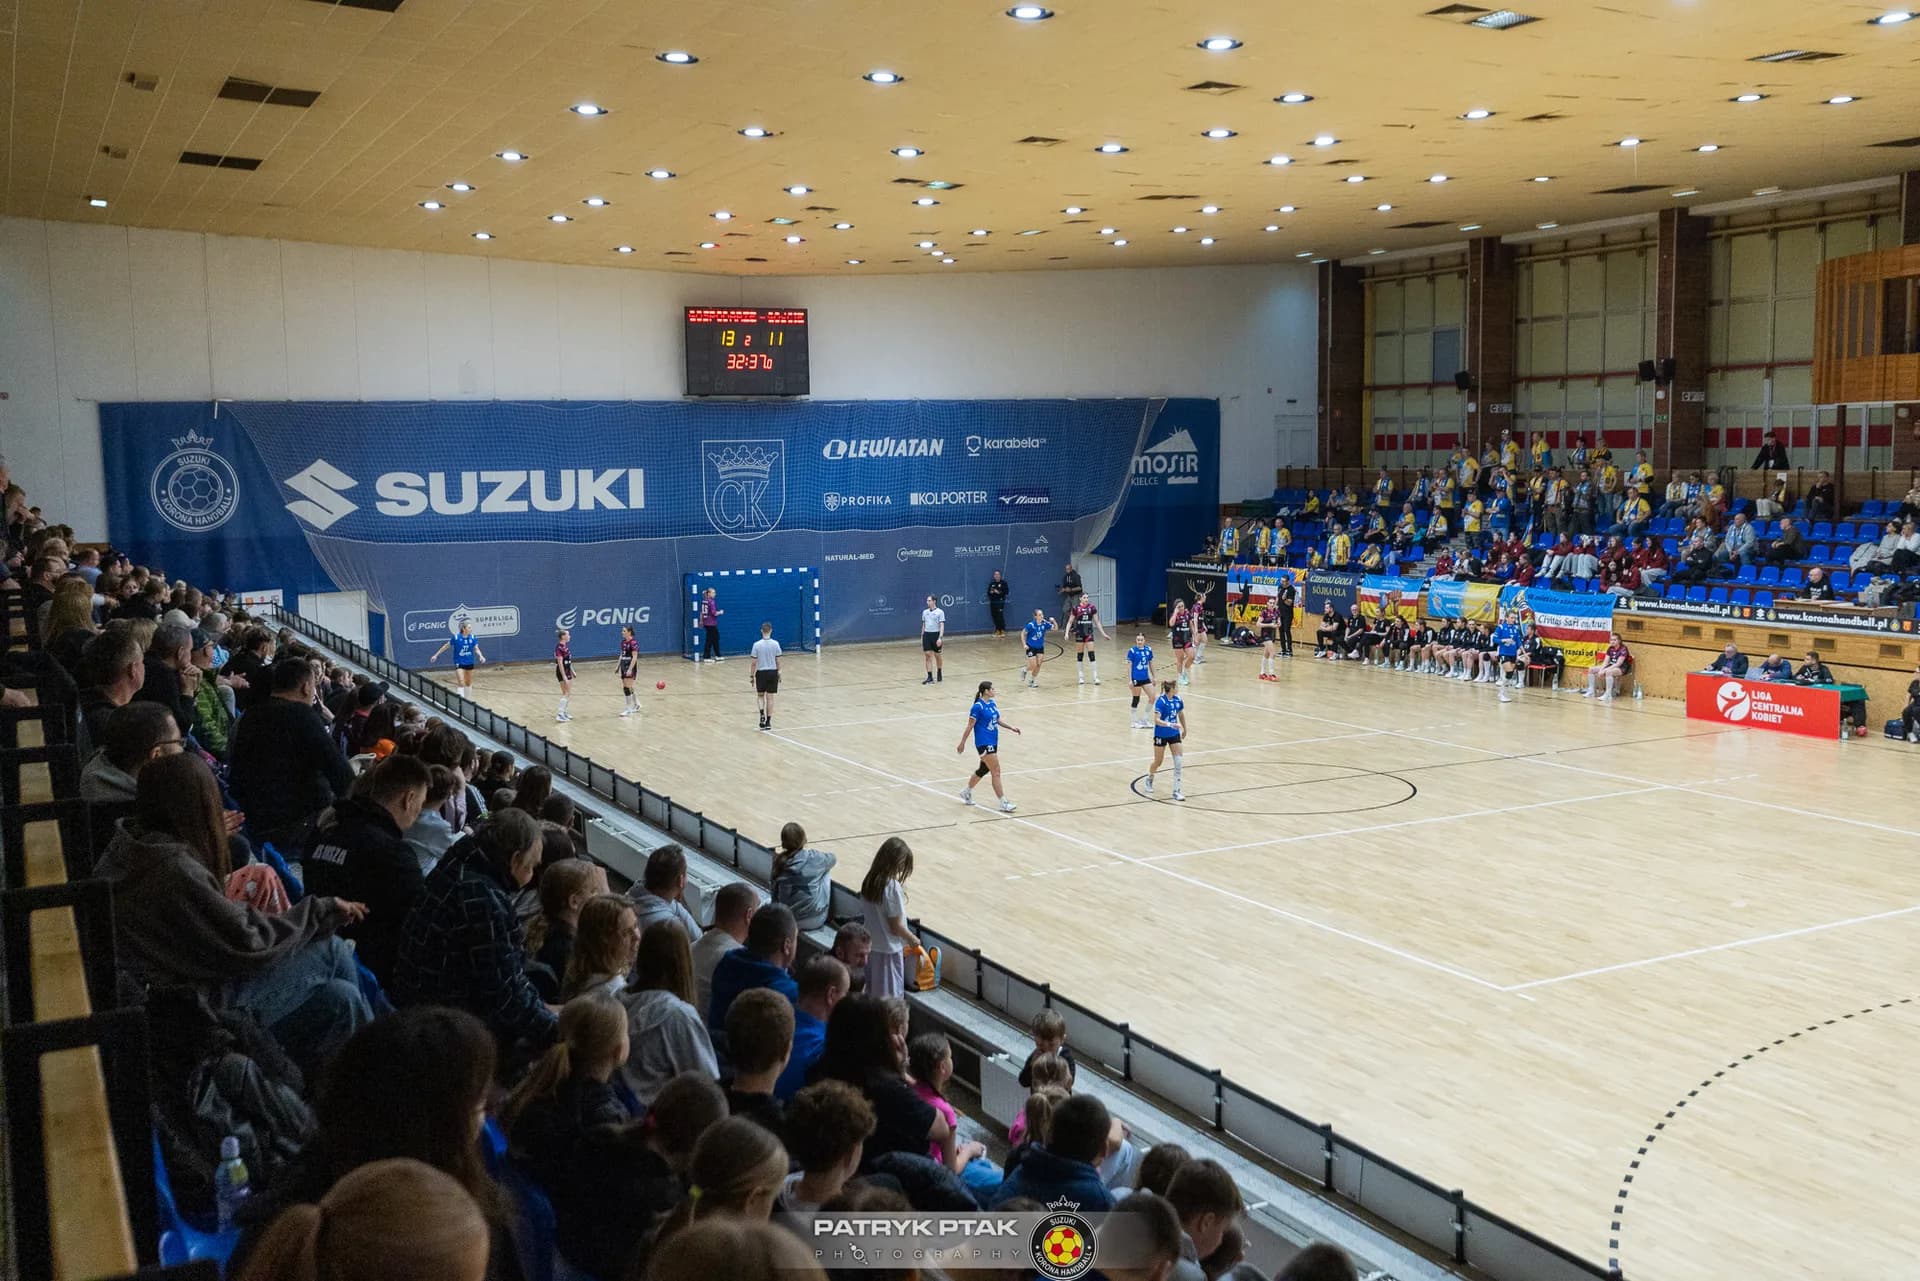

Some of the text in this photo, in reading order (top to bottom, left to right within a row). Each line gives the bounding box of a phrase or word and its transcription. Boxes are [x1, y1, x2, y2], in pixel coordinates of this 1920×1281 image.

[722, 330, 783, 346] 13 2 11
[848, 437, 944, 458] LEWIATAN
[984, 437, 1040, 449] karabela
[176, 455, 211, 466] SUZUKI
[1131, 477, 1159, 486] KIELCE
[375, 468, 645, 517] SUZUKI
[919, 491, 988, 505] KOLPORTER
[713, 480, 771, 529] CK
[841, 495, 892, 506] PROFIKA
[161, 495, 233, 526] KORONA HANDBALL
[825, 553, 875, 562] NATURAL-MED
[1335, 577, 1353, 586] GOLA
[1333, 587, 1347, 597] OLA
[1638, 600, 1731, 617] www.koronahandball.pl
[476, 615, 514, 623] SUPERLIGA
[582, 606, 651, 626] PGNiG
[1778, 612, 1888, 630] www.koronahandball.pl
[418, 621, 447, 630] PGNiG
[1752, 690, 1772, 702] LIGA
[1751, 702, 1804, 717] CENTRALNA
[1751, 711, 1783, 724] KOBIET
